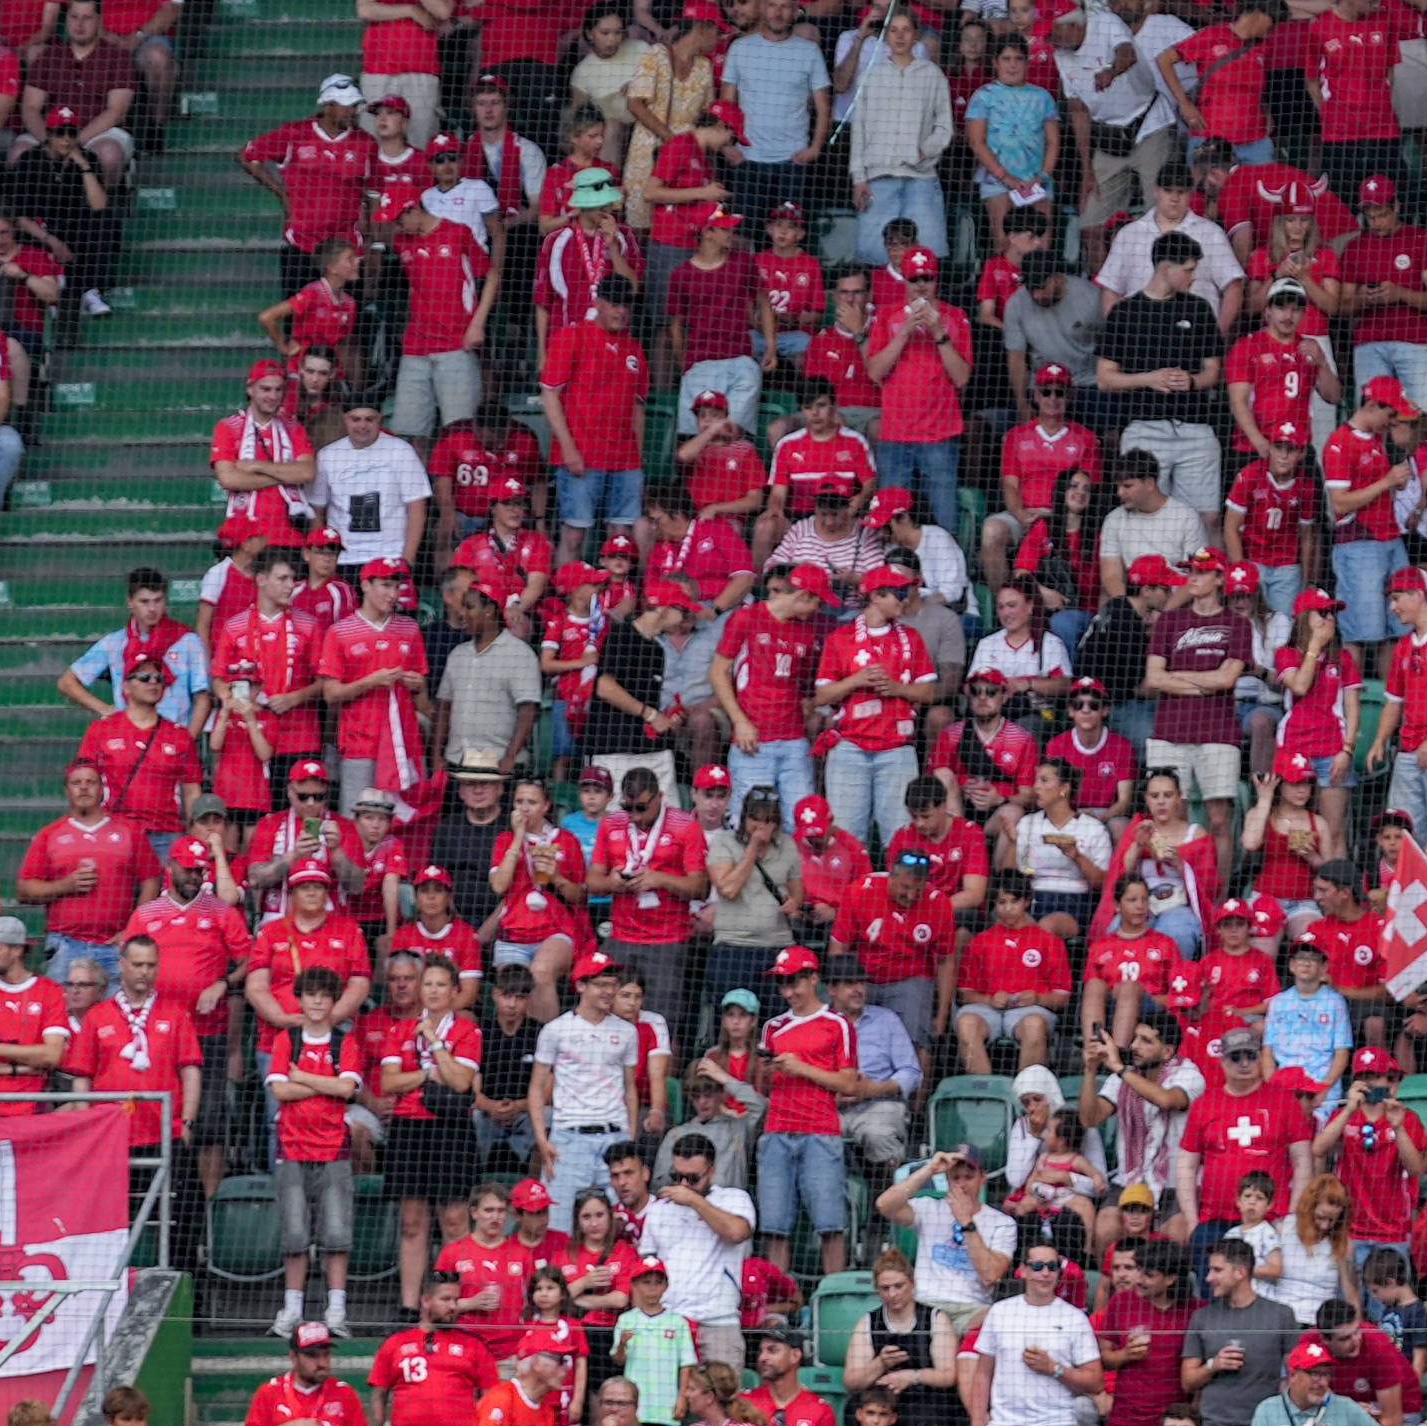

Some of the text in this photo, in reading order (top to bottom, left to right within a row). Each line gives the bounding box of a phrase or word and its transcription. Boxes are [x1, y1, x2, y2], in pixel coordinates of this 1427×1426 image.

[1283, 371, 1299, 399] 9
[456, 464, 490, 488] 69
[1117, 962, 1140, 983] 19
[398, 1357, 428, 1384] 13
